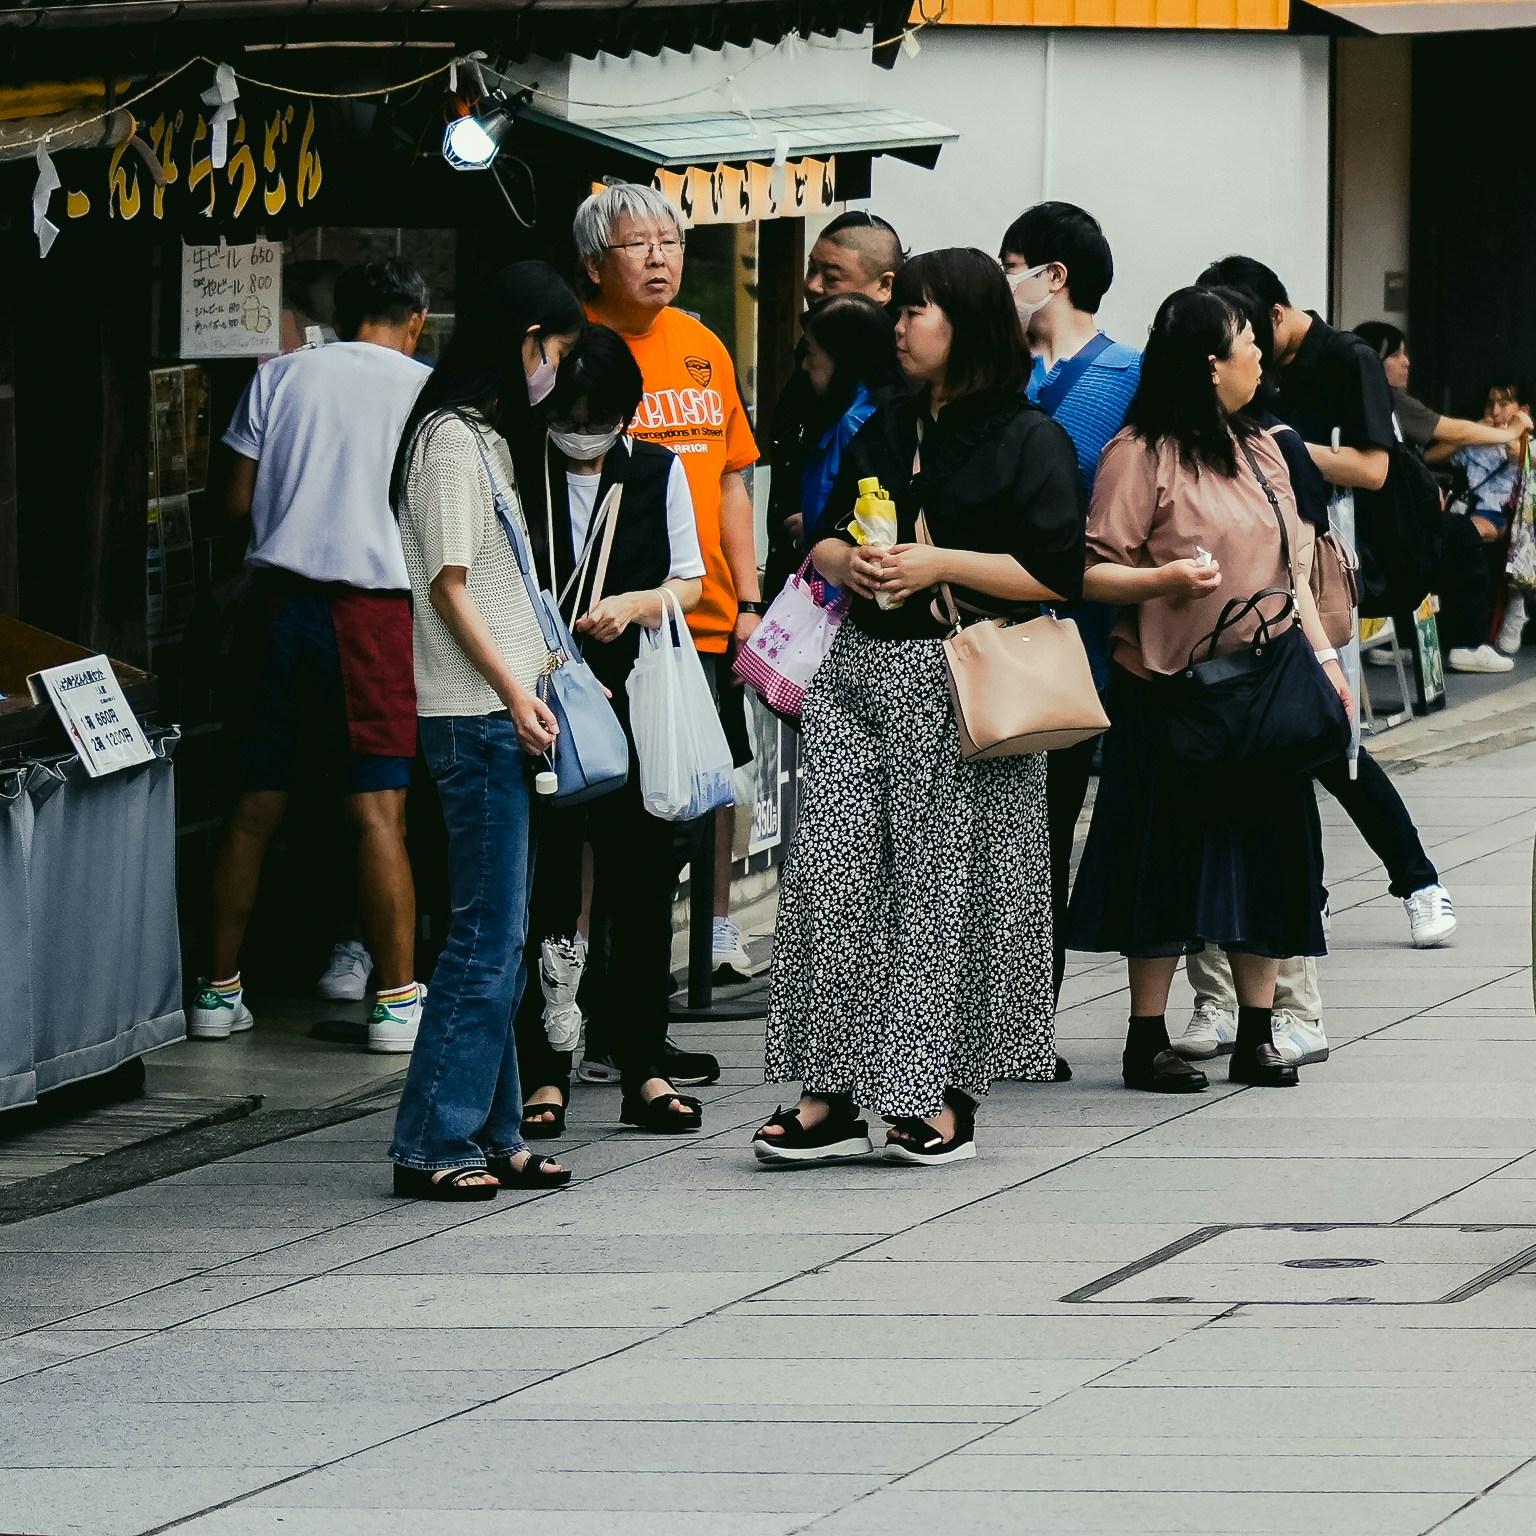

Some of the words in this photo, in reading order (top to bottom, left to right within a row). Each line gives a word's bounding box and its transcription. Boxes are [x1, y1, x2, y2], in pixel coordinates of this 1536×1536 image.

[250, 245, 274, 265] 650
[249, 273, 272, 294] 800
[633, 428, 690, 441] Perceptions
[701, 426, 724, 437] Street
[667, 443, 708, 454] ARRIOR
[95, 708, 119, 726] 660円
[105, 727, 134, 747] 1200円
